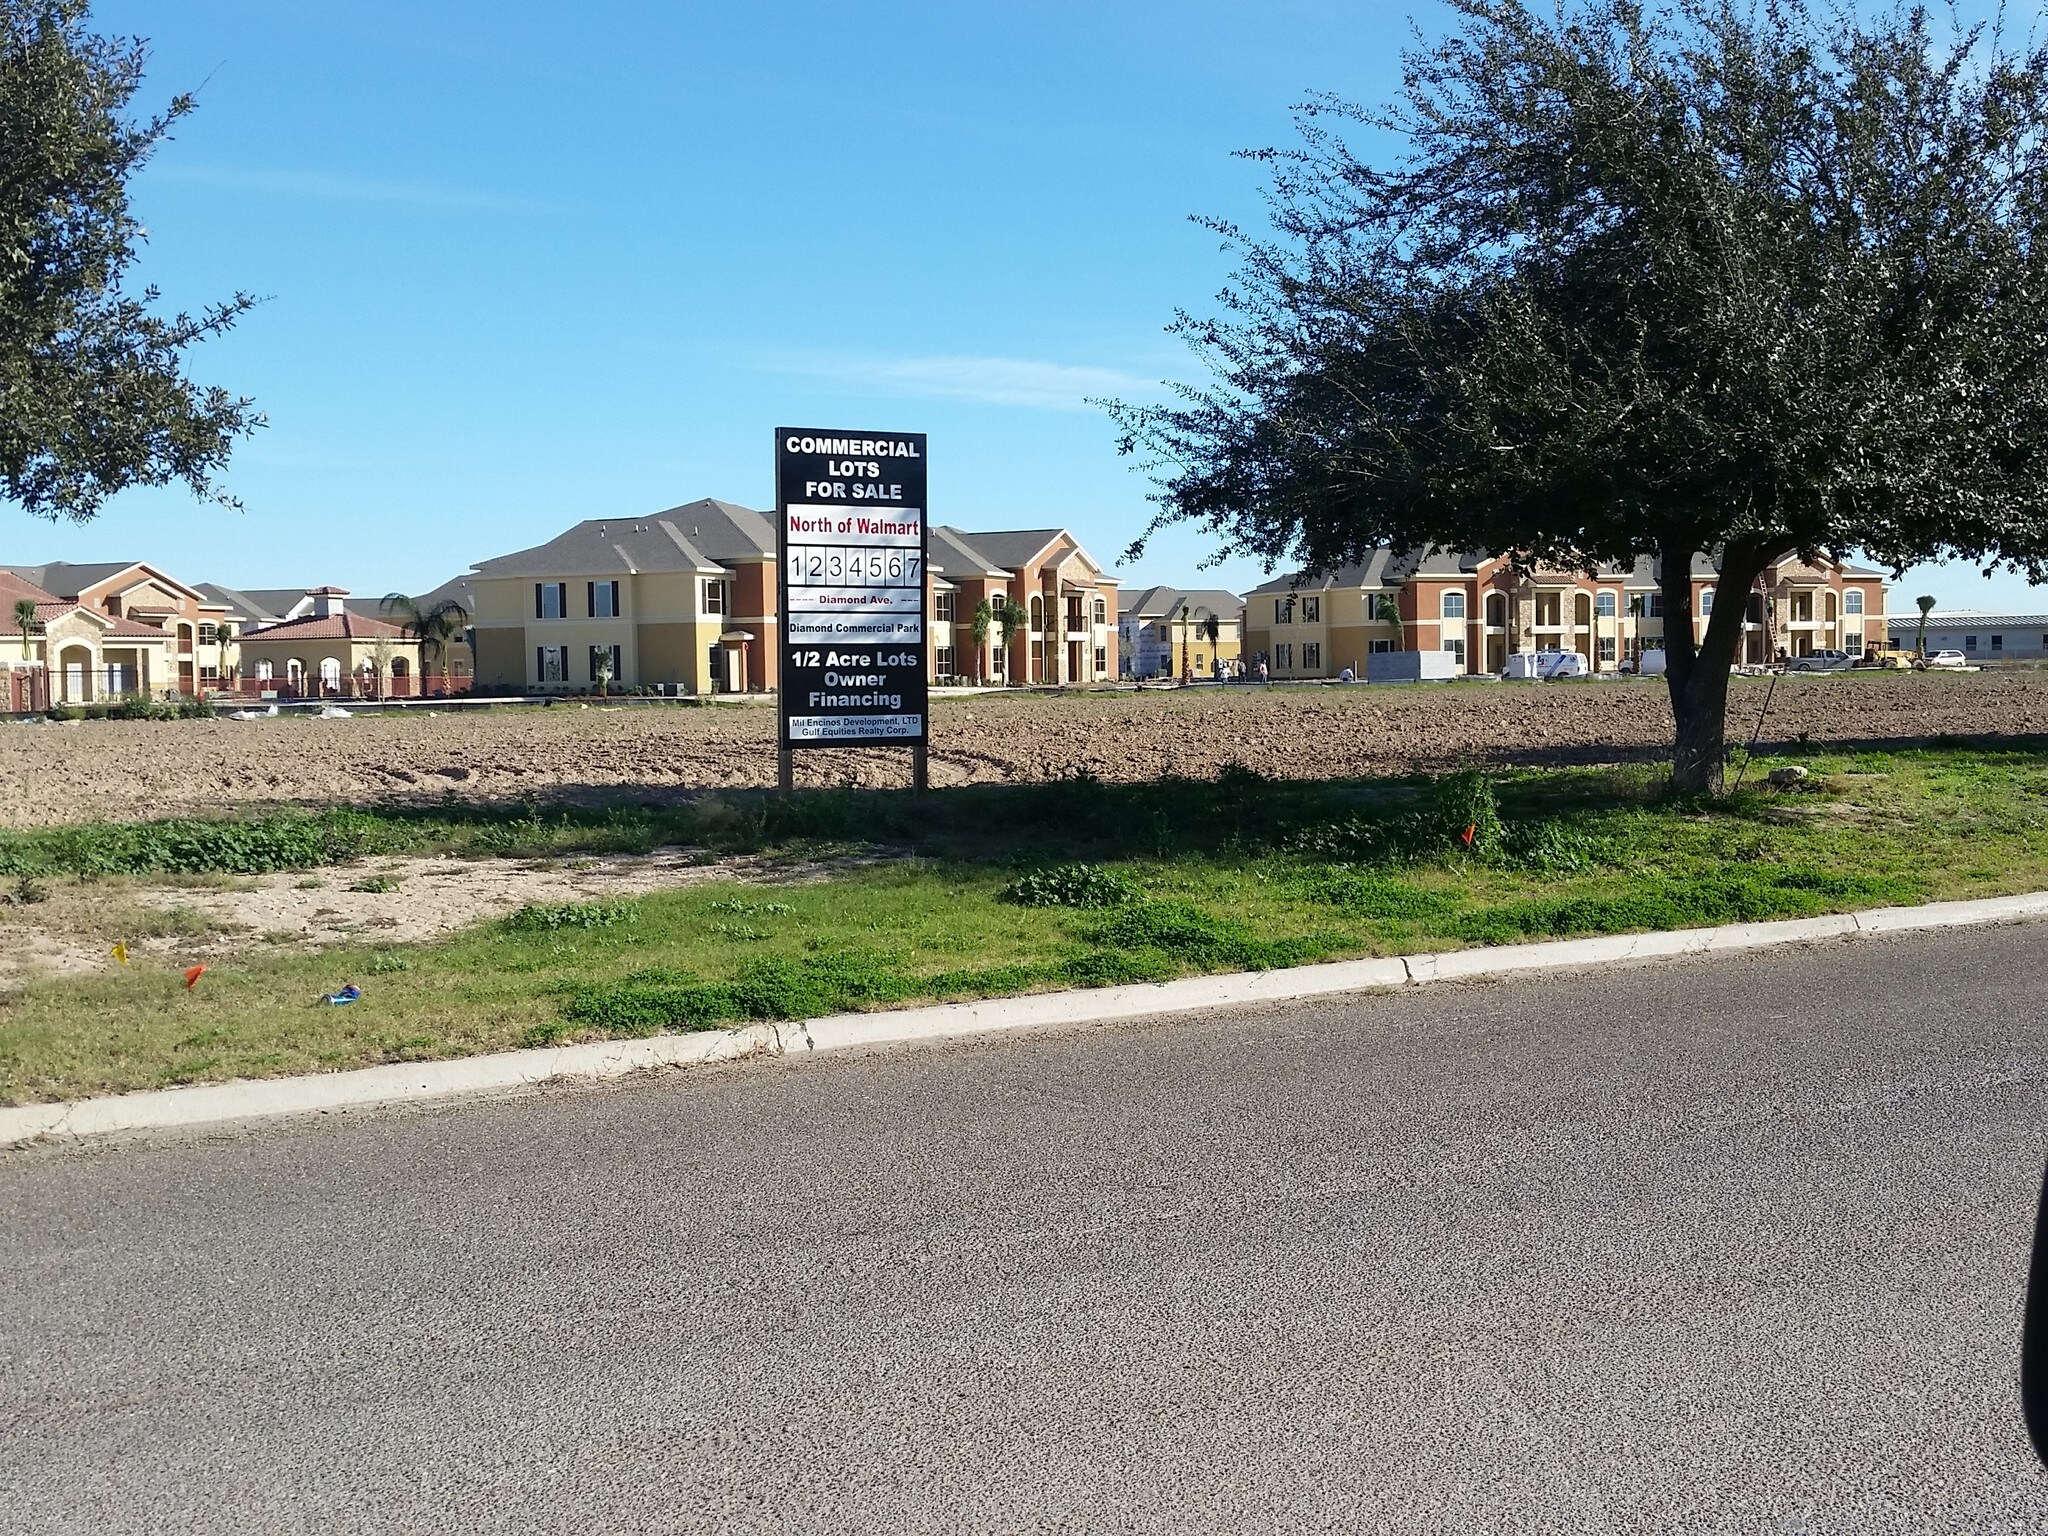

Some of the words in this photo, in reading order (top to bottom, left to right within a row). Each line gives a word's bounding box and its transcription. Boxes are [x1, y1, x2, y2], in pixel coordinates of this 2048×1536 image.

[786, 436, 920, 458] COMMERCIAL
[828, 460, 880, 478] LOTS
[805, 481, 847, 498] FOR
[852, 482, 903, 500] SALE
[790, 516, 832, 533] North
[837, 517, 852, 534] of
[857, 517, 919, 536] Walmart
[819, 595, 867, 605] Diamond
[869, 595, 893, 605] Ave.
[789, 623, 833, 633] Diamond
[835, 623, 894, 633] Commercial
[897, 623, 920, 633] Park
[791, 651, 820, 668] 1/2
[825, 651, 871, 667] Acre
[876, 651, 918, 667] Lots
[824, 671, 887, 687] Owner
[809, 691, 902, 710] Financing
[807, 718, 841, 727] Encinos
[902, 716, 918, 725] LTD
[802, 727, 820, 736] Gulf
[822, 727, 856, 737] Equities
[858, 726, 884, 736] Realty
[886, 726, 909, 736] Corp.
